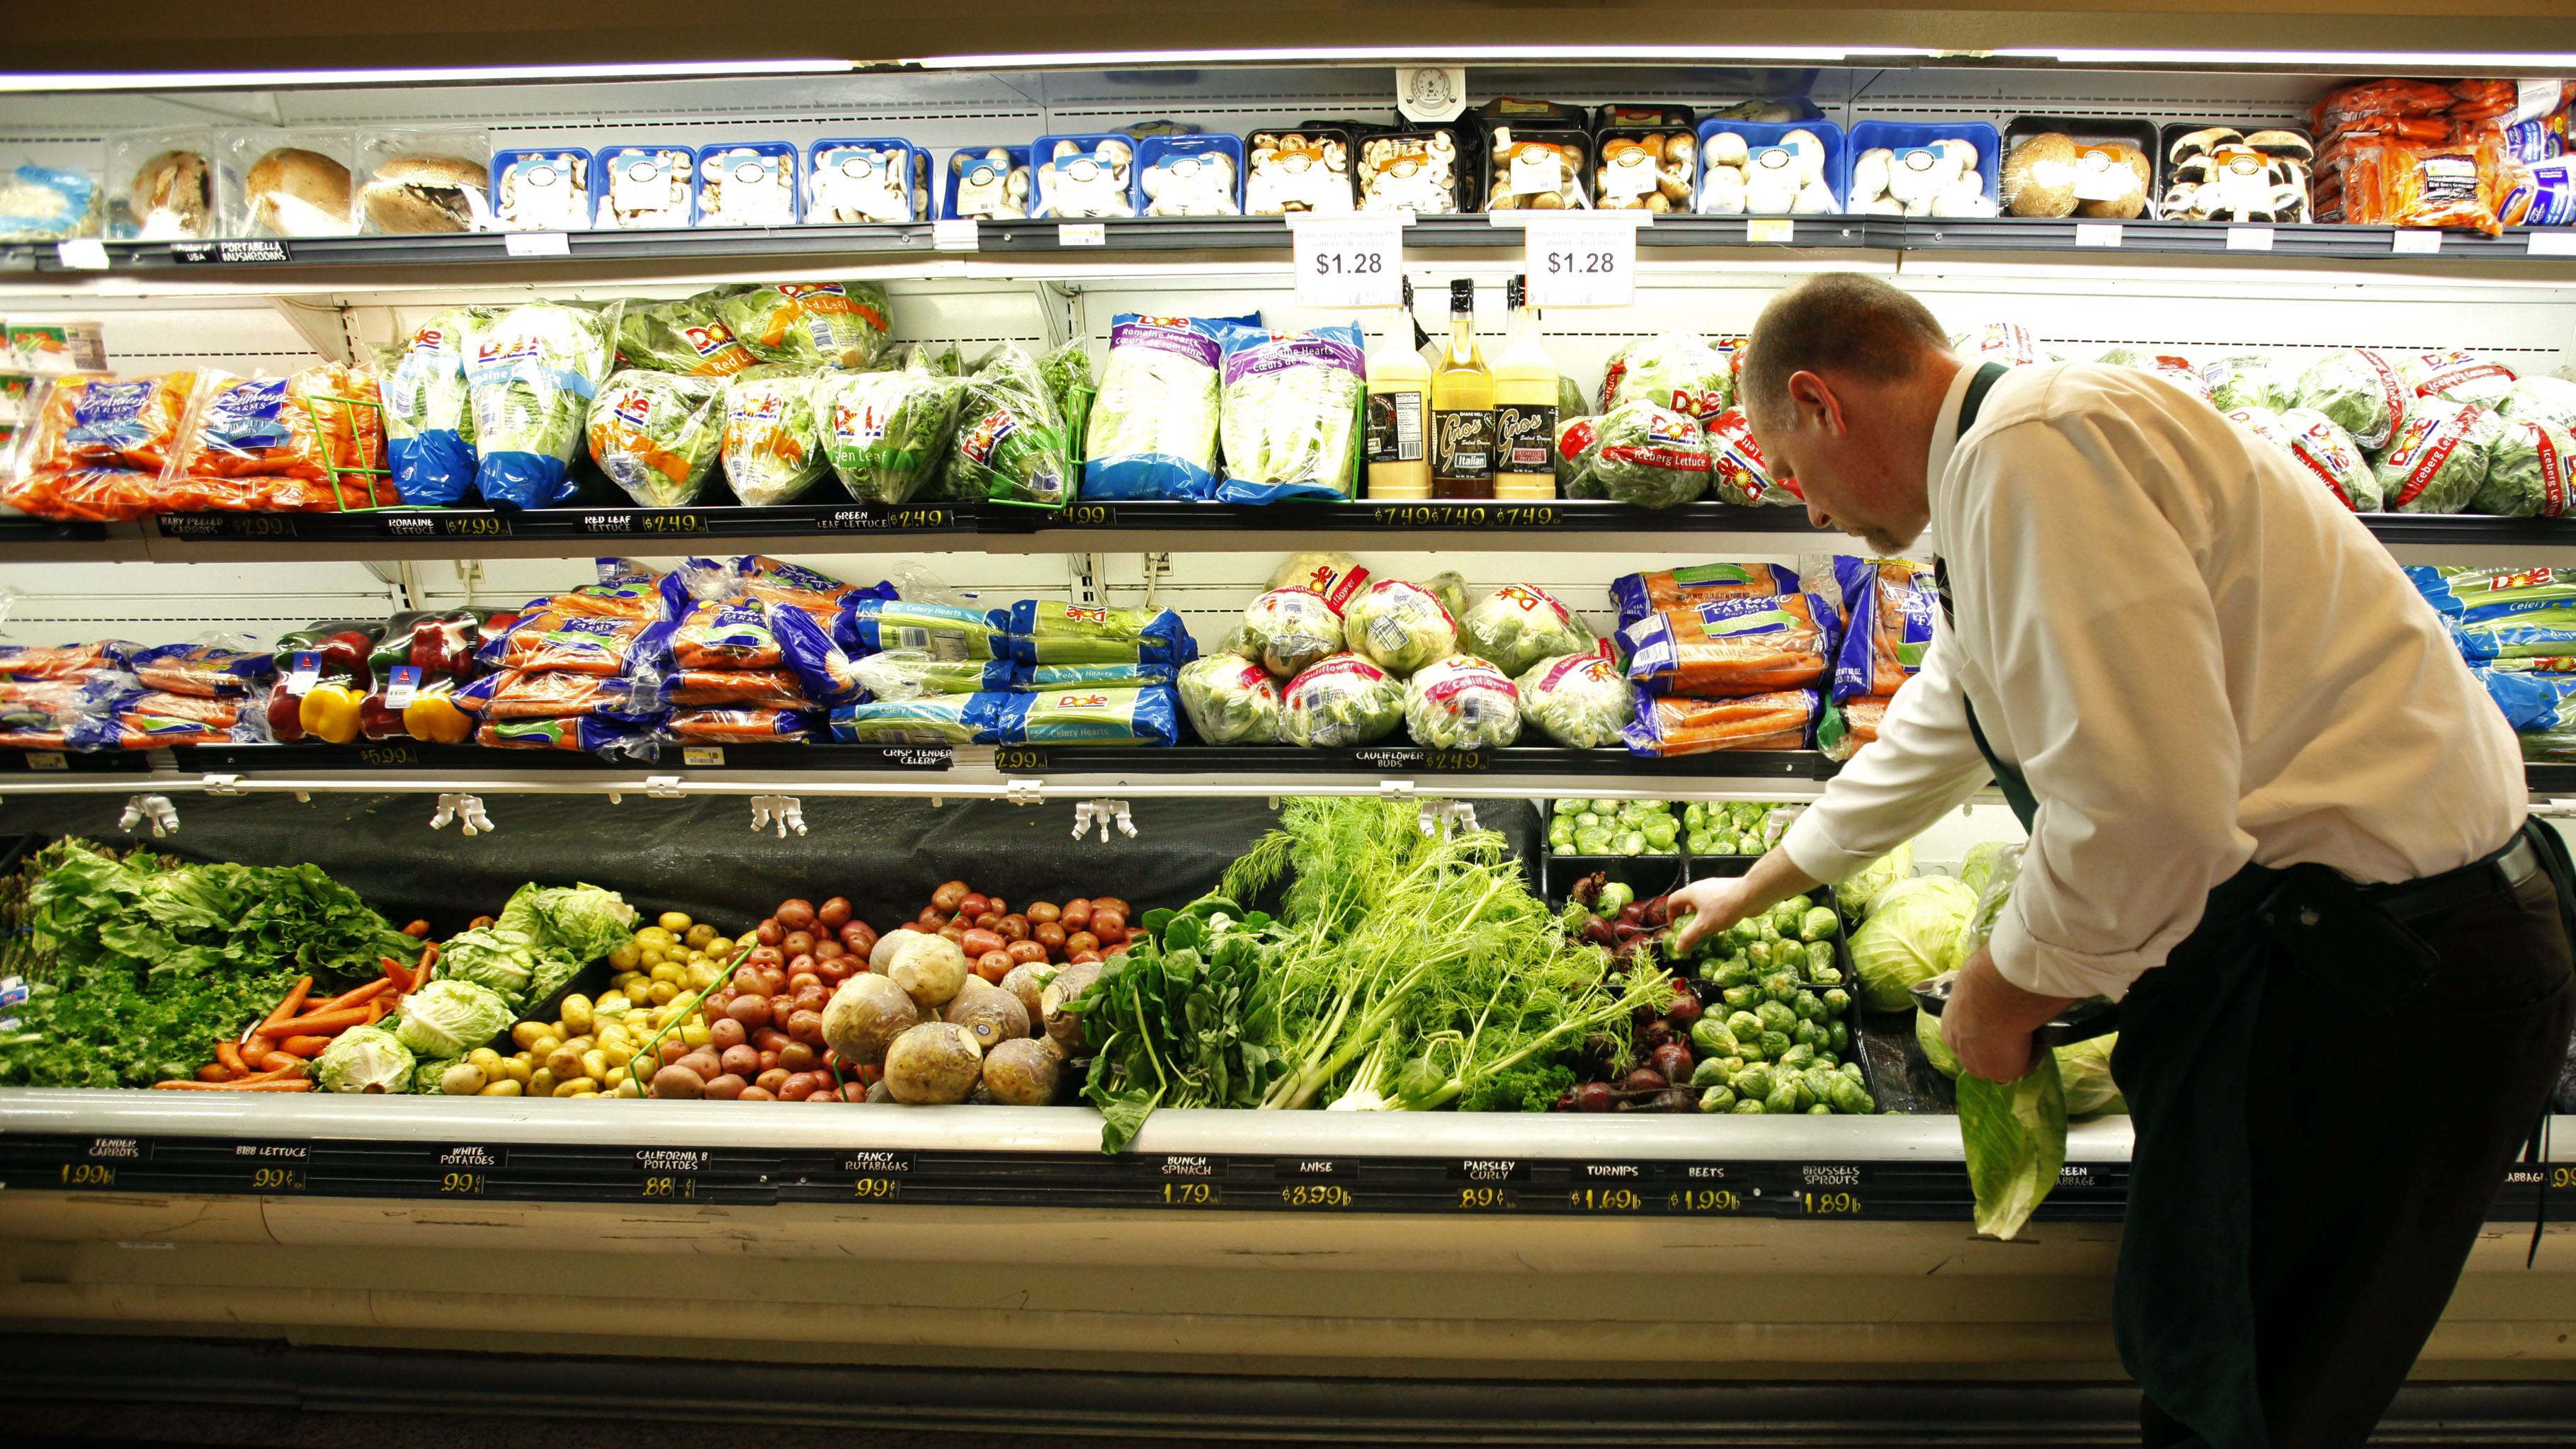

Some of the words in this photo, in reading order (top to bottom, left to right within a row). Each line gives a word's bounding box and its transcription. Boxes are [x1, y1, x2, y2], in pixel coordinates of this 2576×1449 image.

[220, 242, 283, 252] PORTABELLA
[186, 253, 206, 261] USA
[222, 251, 286, 261] MUSHROOMS
[1316, 253, 1382, 276] $1.28
[1548, 251, 1614, 275] $1.28
[1123, 329, 1163, 339] Romaine
[1167, 335, 1199, 347] Hearts
[1147, 339, 1159, 347] de
[1303, 345, 1334, 355] Hearts
[713, 359, 738, 373] Red
[1253, 358, 1282, 372] Cœurs
[1672, 389, 1719, 414] Dole
[859, 450, 885, 462] Leaf
[1458, 456, 1485, 465] Italian
[1635, 448, 1672, 465] Iceberg
[1675, 454, 1706, 467] Lettuce
[2543, 448, 2555, 486] Iceberg
[161, 516, 182, 526] BABY
[584, 516, 605, 524] RED
[835, 511, 868, 520] GREEN
[890, 510, 942, 528] $2.49
[1375, 507, 1429, 525] $7.49
[1431, 507, 1485, 525] $7.49
[1497, 507, 1552, 525] $7.49
[388, 518, 434, 527] ROMAINE
[645, 515, 696, 532] $2.49
[2492, 568, 2550, 589] Dole
[907, 605, 933, 615] Celery
[1713, 603, 1769, 615] FARMS
[2510, 601, 2547, 612] Celery
[1066, 608, 1106, 622] Dole
[1298, 662, 1356, 683] Cauliflower
[1452, 678, 1508, 691] Cauliflower
[1058, 694, 1108, 707] Dole
[1356, 751, 1424, 760] CAULIFLOWER
[1426, 752, 1480, 770] $2.49
[94, 1139, 137, 1148] TENDER
[89, 1147, 139, 1157] CARROTS
[236, 1146, 256, 1156] BIBB
[259, 1147, 307, 1157] LETTUCE
[453, 1147, 484, 1156] WHITE
[637, 1151, 697, 1161] CALIFORNIA
[701, 1152, 708, 1161] B
[857, 1152, 894, 1161] FANCY
[440, 1155, 494, 1165] POTATOES
[644, 1160, 698, 1171] POTATOES
[1168, 1157, 1206, 1166] BUNCH
[845, 1161, 909, 1171] RUTABAGAS
[1161, 1166, 1211, 1176] SPINACH
[1300, 1162, 1332, 1172] ANISE
[1463, 1161, 1515, 1171] PARSLEY
[1587, 1166, 1639, 1176] TURNIPS
[1803, 1166, 1860, 1176] BRUSSELS
[2058, 1167, 2087, 1176] REEN
[1470, 1171, 1508, 1180] CURLY
[1689, 1167, 1724, 1177] BEETS
[2505, 1172, 2548, 1183] ABBAG
[1805, 1176, 1859, 1185] SPROUTS
[2055, 1176, 2095, 1186] ABBAGE
[1163, 1183, 1210, 1203] 1.79
[1282, 1185, 1341, 1205] $3.99
[1458, 1187, 1493, 1208] .89
[1571, 1189, 1632, 1210] $1.69
[1670, 1190, 1731, 1210] $1.99
[1805, 1193, 1850, 1213] 1.89
